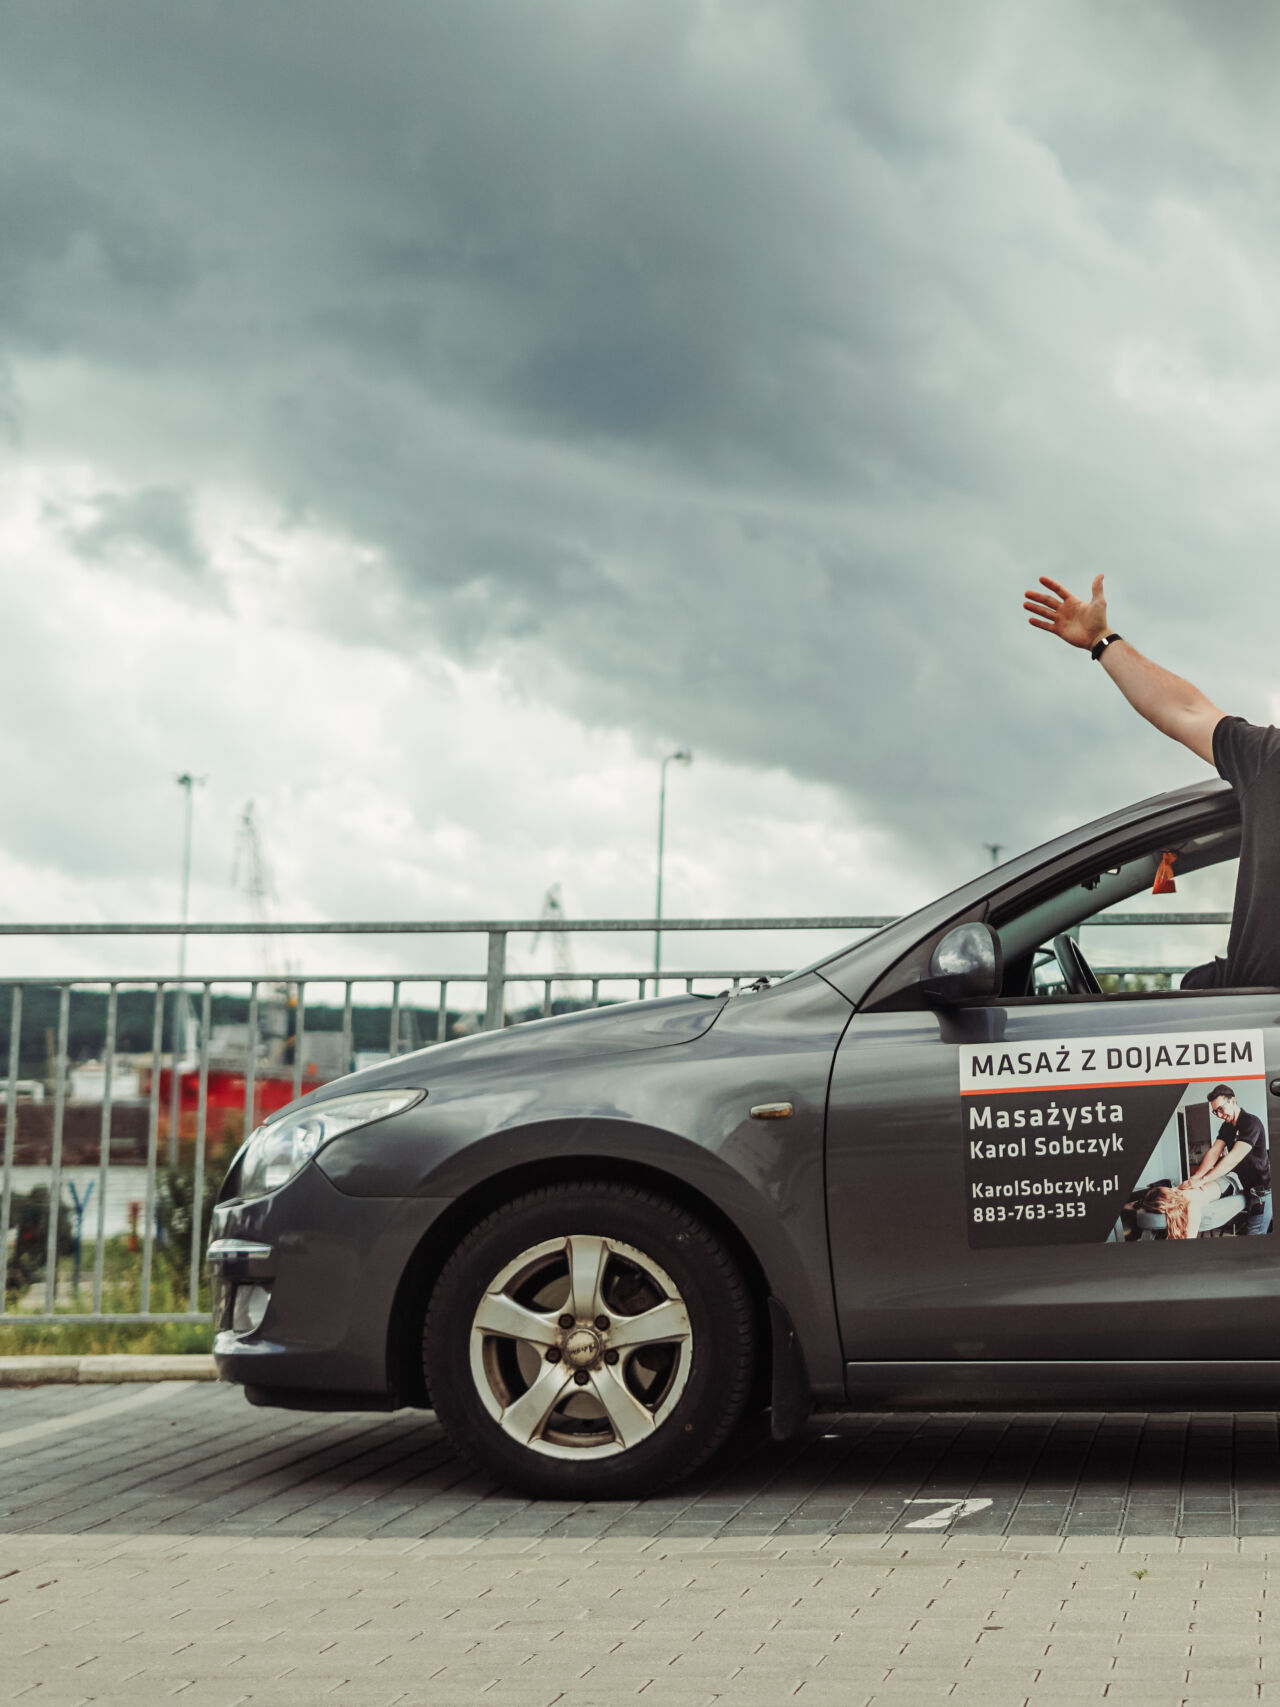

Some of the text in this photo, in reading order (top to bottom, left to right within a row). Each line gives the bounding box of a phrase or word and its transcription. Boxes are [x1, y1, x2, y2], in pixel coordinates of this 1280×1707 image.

[971, 1041, 1253, 1077] MASAŻ Z DOJAZDEM
[969, 1101, 1124, 1131] Masażysta
[970, 1132, 1124, 1159] Karol Sobczyk
[972, 1174, 1119, 1199] KarolSobczyk.pl
[973, 1201, 1087, 1223] 883-763-353
